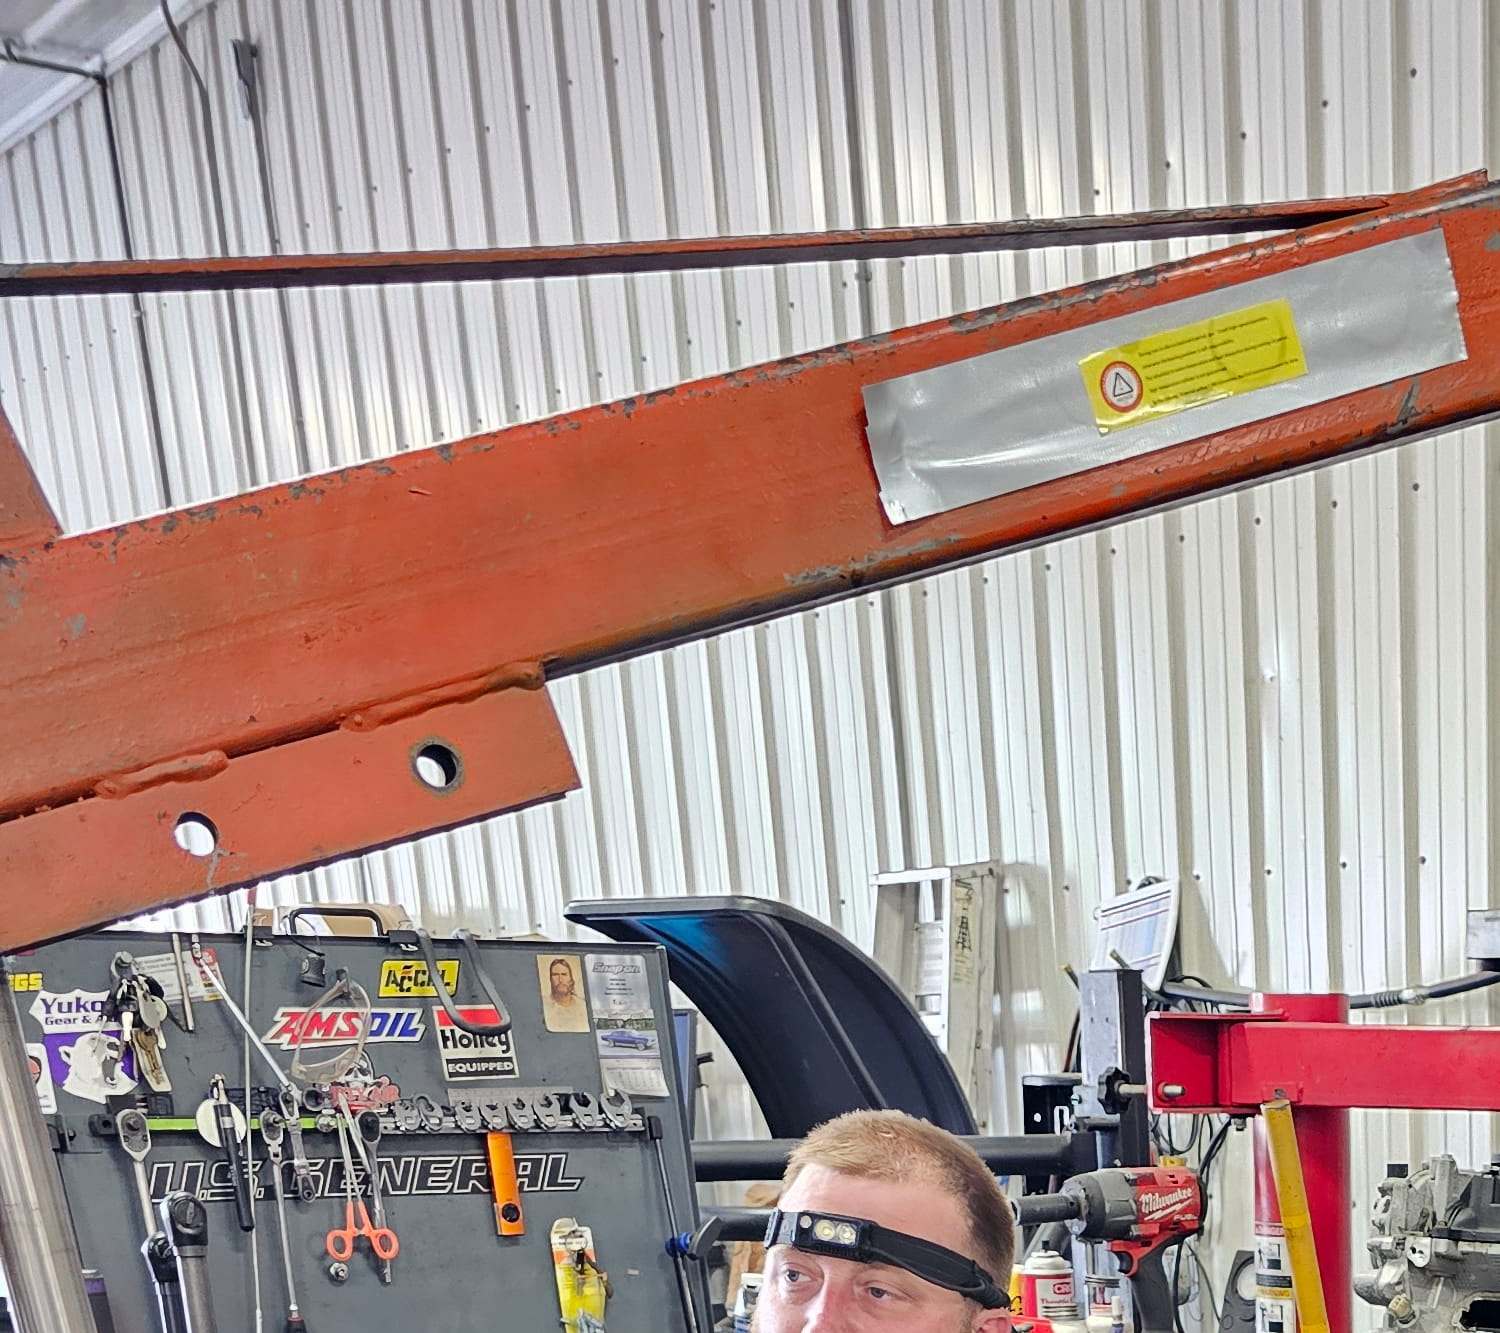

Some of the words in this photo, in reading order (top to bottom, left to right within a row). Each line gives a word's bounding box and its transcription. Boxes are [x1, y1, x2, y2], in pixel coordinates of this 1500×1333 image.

[40, 997, 105, 1014] Yuko
[45, 1015, 78, 1026] Gear
[82, 1015, 91, 1024] &
[272, 1011, 419, 1043] AMSOIL
[448, 1061, 514, 1074] EQUIPPED
[1140, 1188, 1193, 1214] Milwaukee
